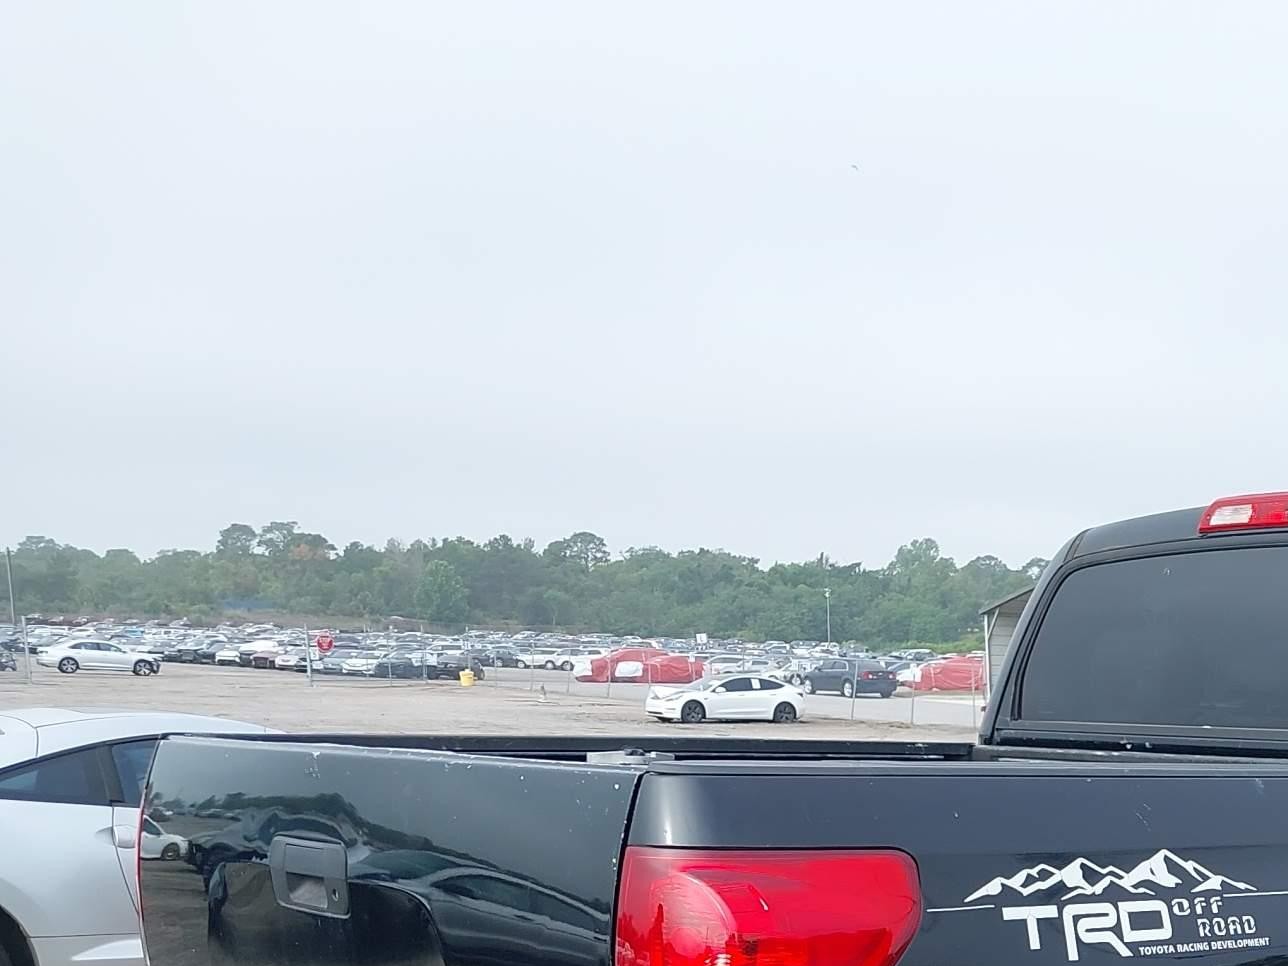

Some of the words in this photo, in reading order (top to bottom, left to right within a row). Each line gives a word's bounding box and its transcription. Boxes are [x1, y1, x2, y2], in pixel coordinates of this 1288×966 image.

[1171, 896, 1223, 916] OFF
[1001, 899, 1173, 962] TRD
[1197, 915, 1256, 937] ROAD
[1139, 944, 1175, 956] TOYOTA
[1176, 941, 1209, 953] RACING
[1211, 937, 1270, 950] DEVELOPMENT
